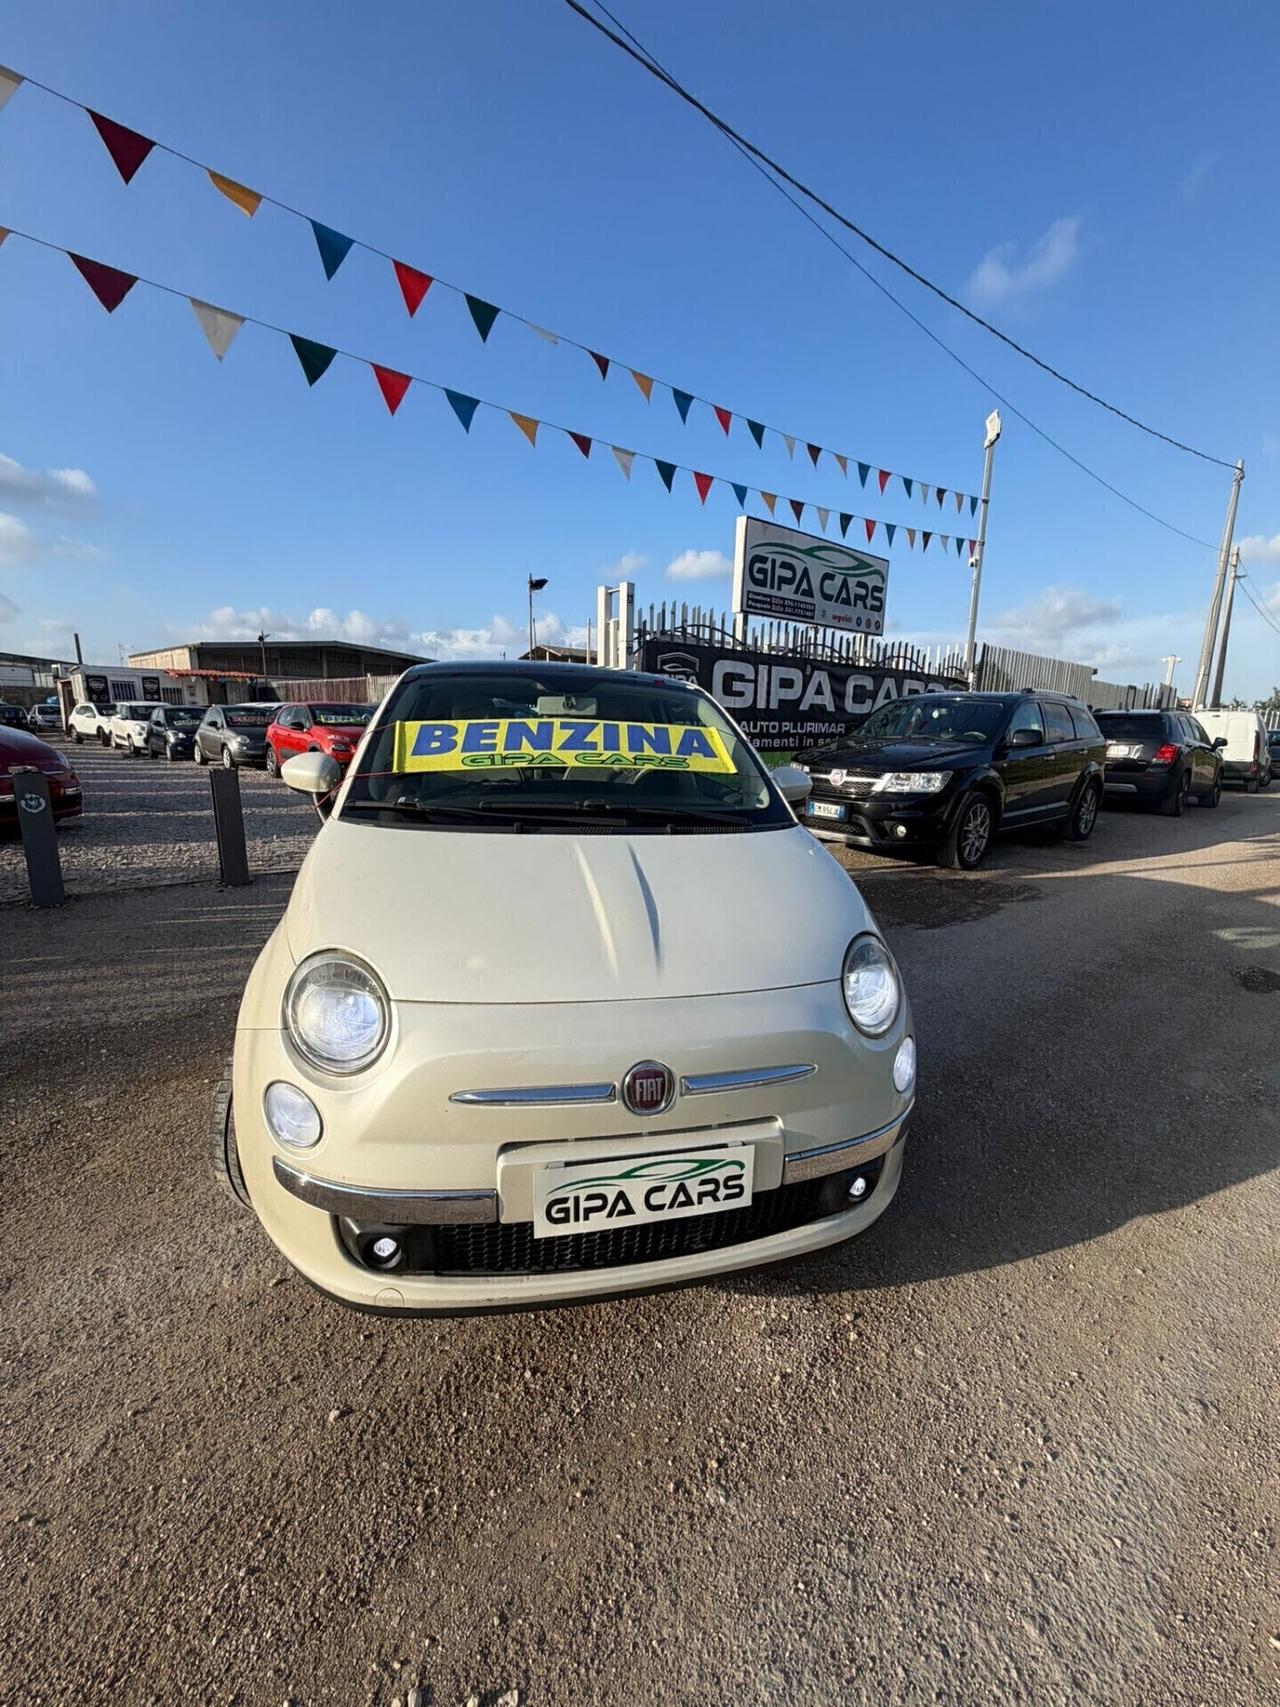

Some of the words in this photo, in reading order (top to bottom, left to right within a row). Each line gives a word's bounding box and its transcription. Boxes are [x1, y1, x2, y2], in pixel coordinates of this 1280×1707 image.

[749, 554, 815, 599] GIPA
[820, 572, 884, 613] CARS
[712, 659, 836, 713] GIPA
[844, 674, 945, 715] CA
[411, 721, 719, 759] BENZINA
[740, 720, 779, 734] AUTO
[803, 736, 814, 748] in
[461, 752, 567, 768] GIPA
[575, 752, 690, 769] CARS
[635, 1077, 664, 1101] FIAT
[545, 1189, 636, 1225] GIPA
[644, 1173, 745, 1212] CARS
